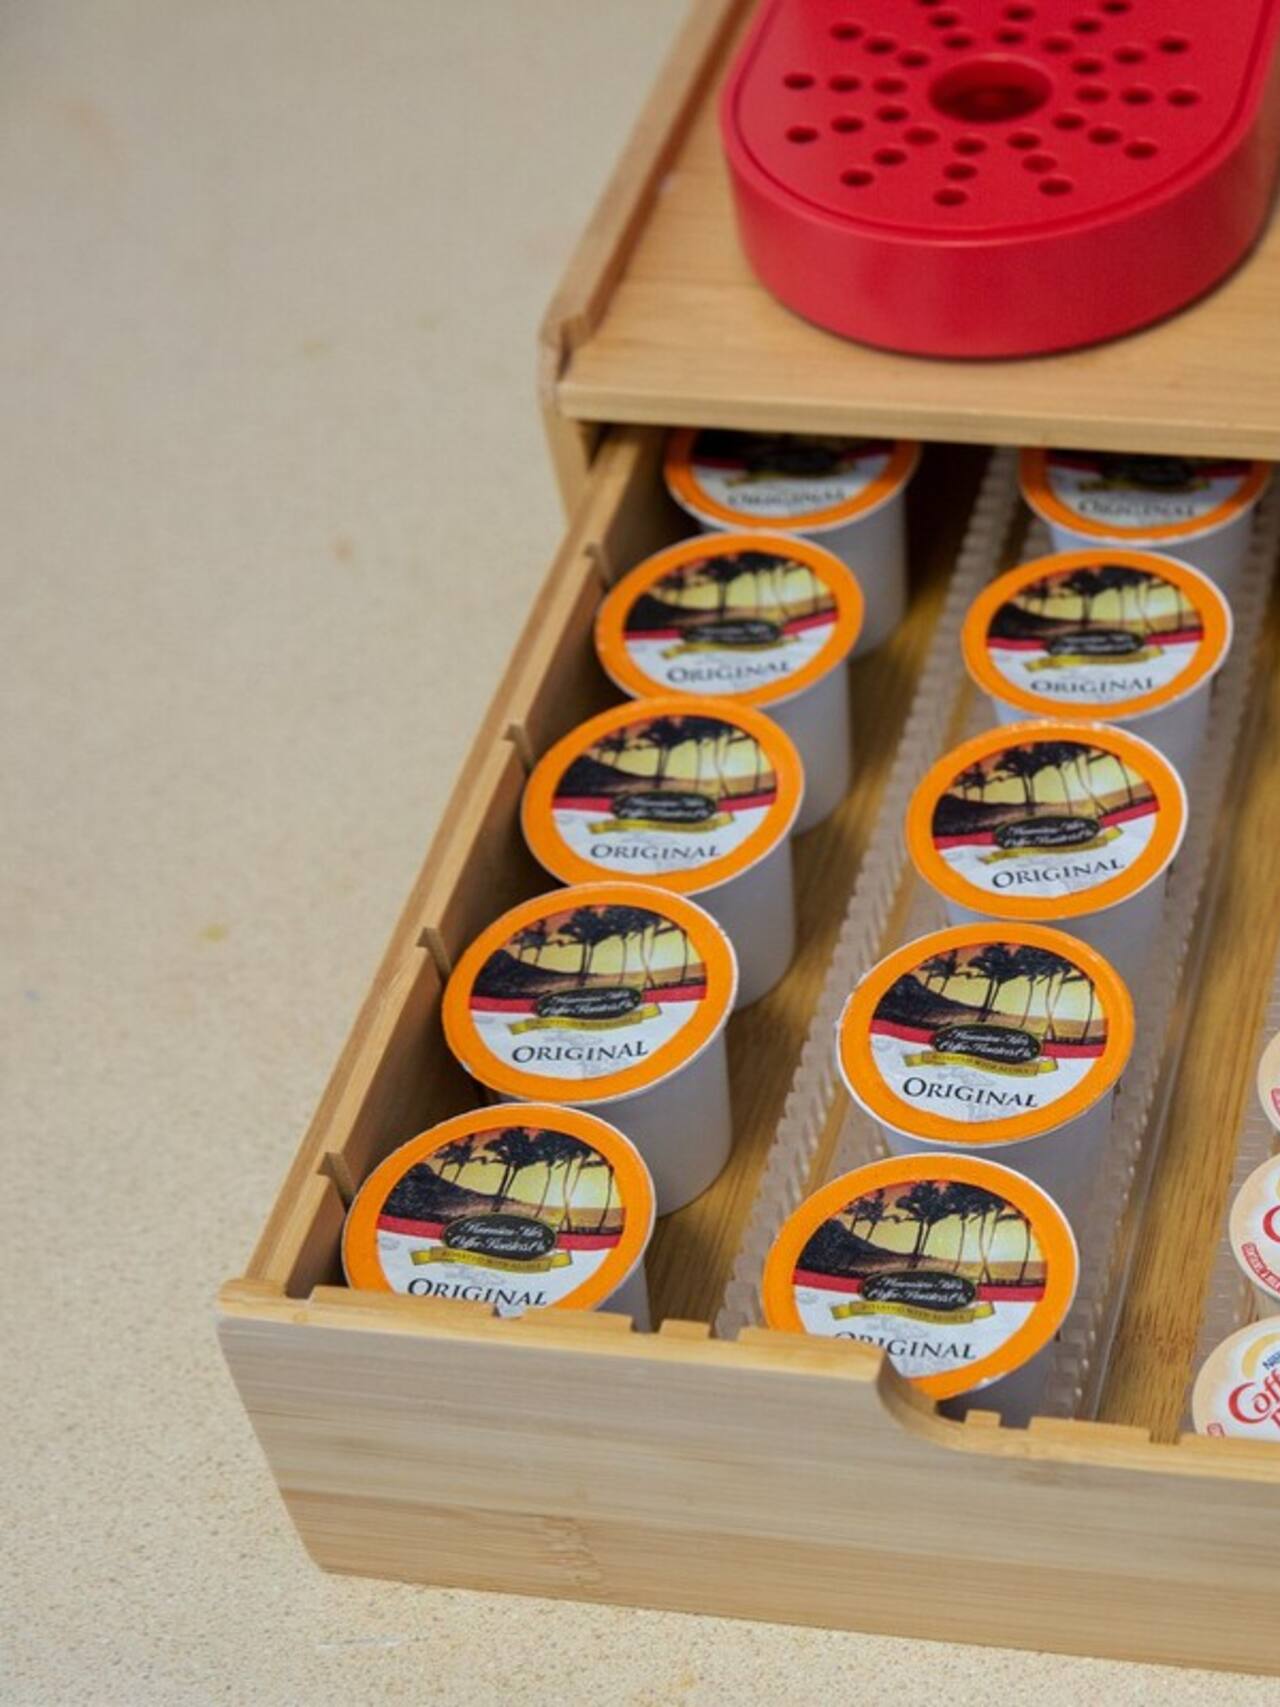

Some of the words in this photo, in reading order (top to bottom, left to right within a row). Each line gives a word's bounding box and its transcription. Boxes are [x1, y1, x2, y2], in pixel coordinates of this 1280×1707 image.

[666, 660, 791, 684] ORIGINAL
[1030, 677, 1156, 694] ORIGINAL
[589, 842, 720, 861] ORIGINAL
[992, 858, 1124, 888] ORIGINAL
[511, 1041, 649, 1064] ORIGINAL
[902, 1077, 1039, 1108] ORIGINAL
[407, 1278, 548, 1306] ORIGINAL
[834, 1331, 976, 1359] IGINAL
